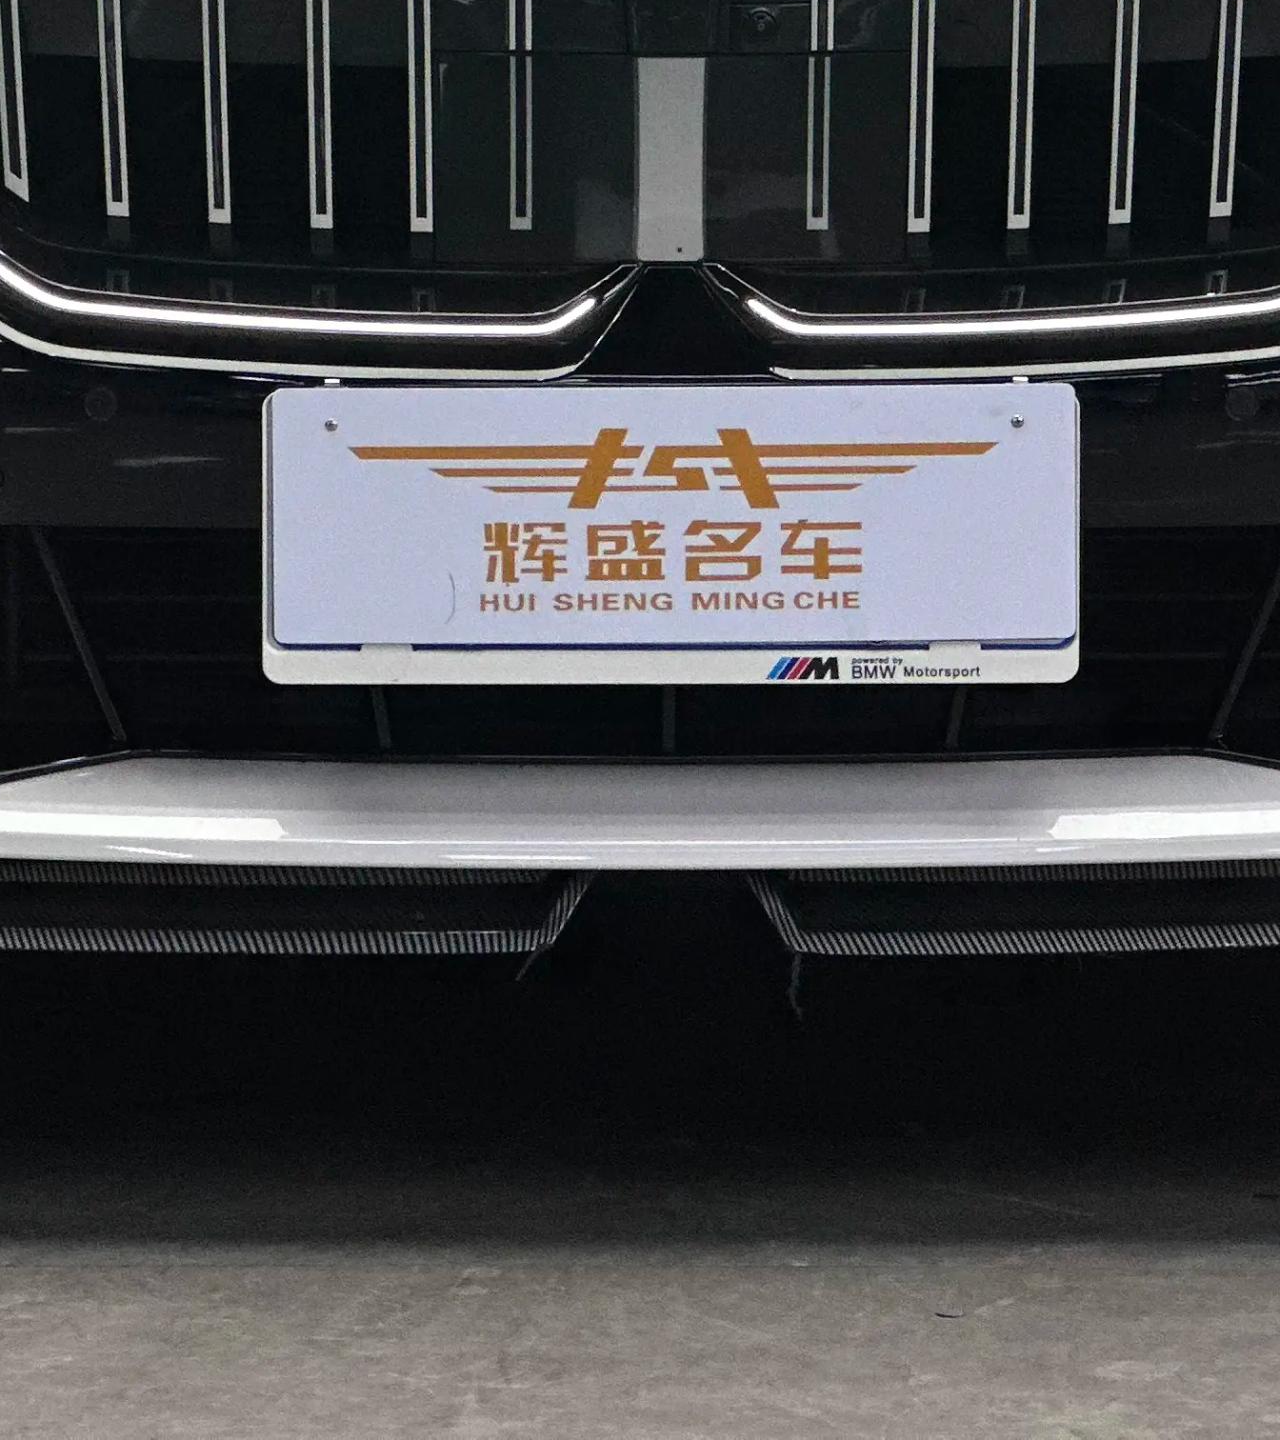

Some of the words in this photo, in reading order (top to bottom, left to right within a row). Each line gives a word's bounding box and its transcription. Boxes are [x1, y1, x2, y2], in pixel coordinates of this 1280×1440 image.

[484, 520, 862, 583] 辉盛名车
[479, 594, 536, 612] HUI
[553, 593, 673, 611] SHENG
[851, 666, 896, 679] BMW
[904, 666, 981, 678] Motorsport
